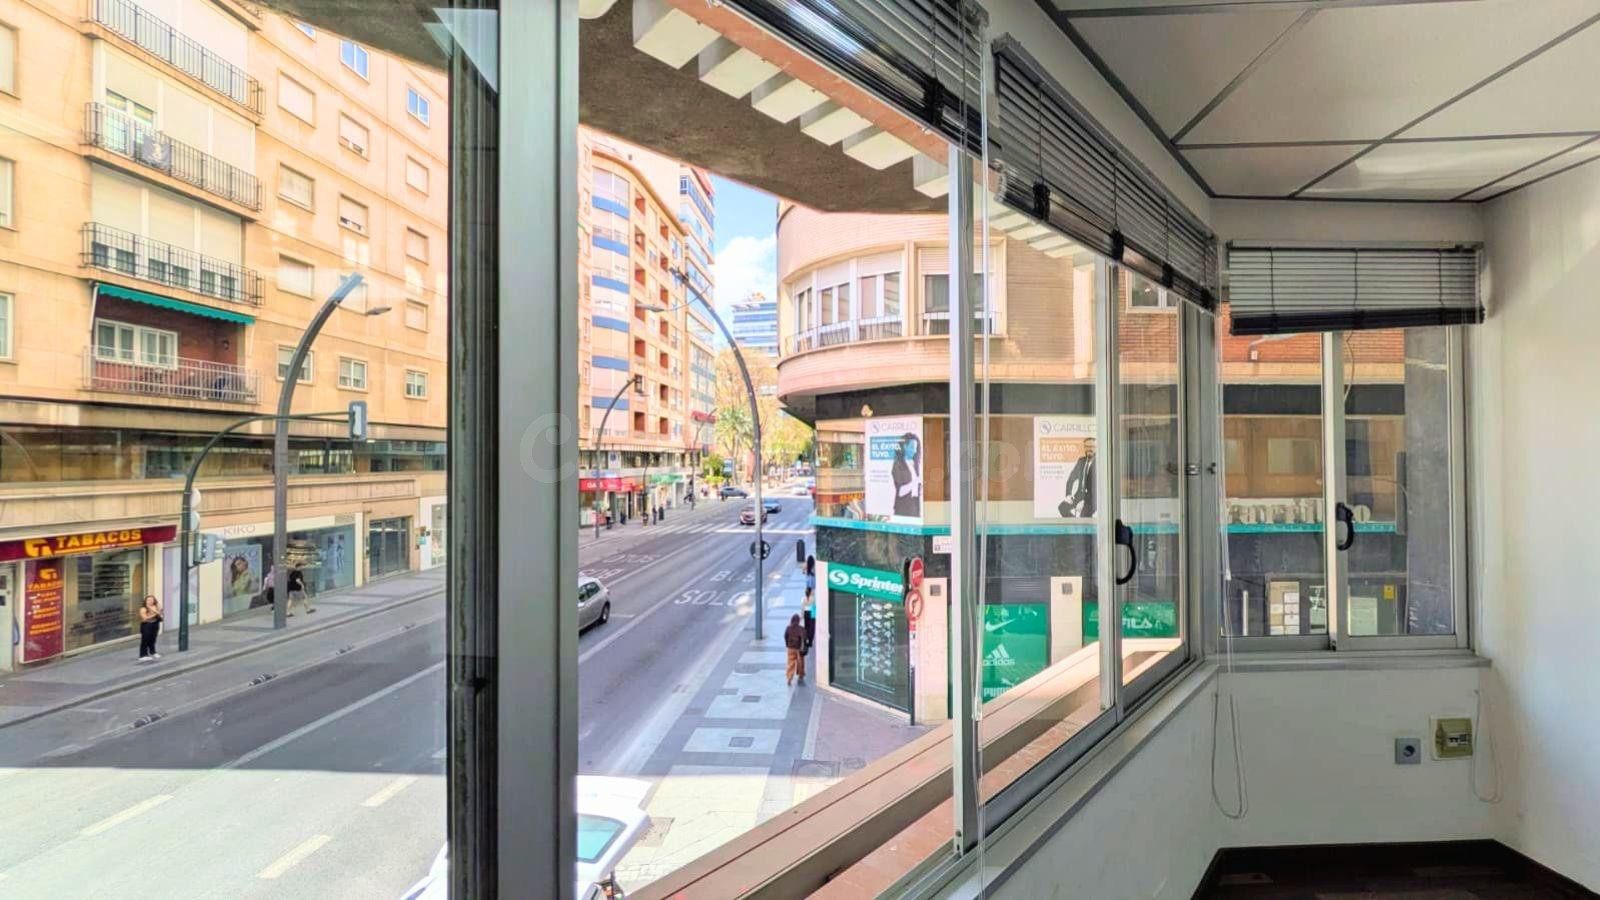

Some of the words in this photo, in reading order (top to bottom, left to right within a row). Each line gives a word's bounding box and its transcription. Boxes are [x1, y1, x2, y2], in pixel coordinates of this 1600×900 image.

[55, 528, 142, 549] TABACOS
[223, 524, 256, 536] KIKO
[849, 572, 905, 595] Sprinter
